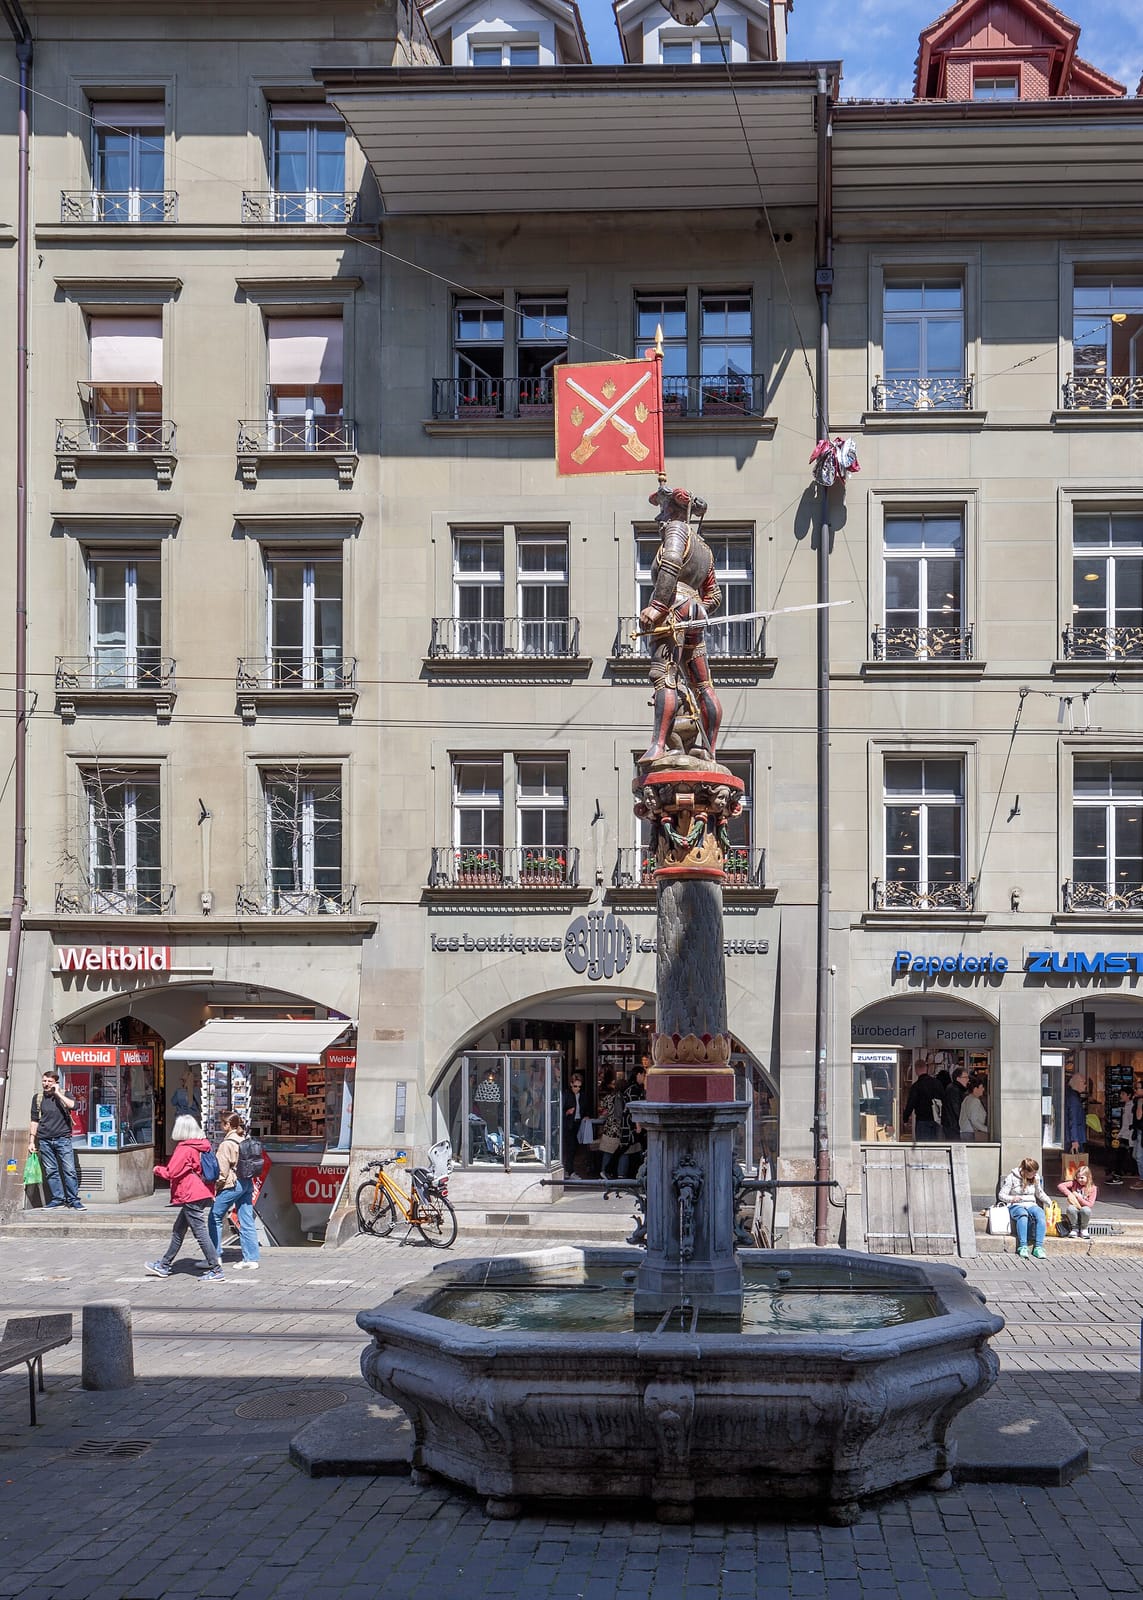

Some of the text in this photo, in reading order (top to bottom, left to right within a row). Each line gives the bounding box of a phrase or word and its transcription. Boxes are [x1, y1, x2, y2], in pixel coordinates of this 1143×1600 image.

[430, 932, 563, 955] les boutiques
[58, 946, 169, 971] Weltbild
[895, 950, 1009, 976] Papeterie
[936, 1029, 987, 1041] Papeterie
[61, 1051, 111, 1063] Weltbild
[123, 1052, 150, 1063] Weltbild
